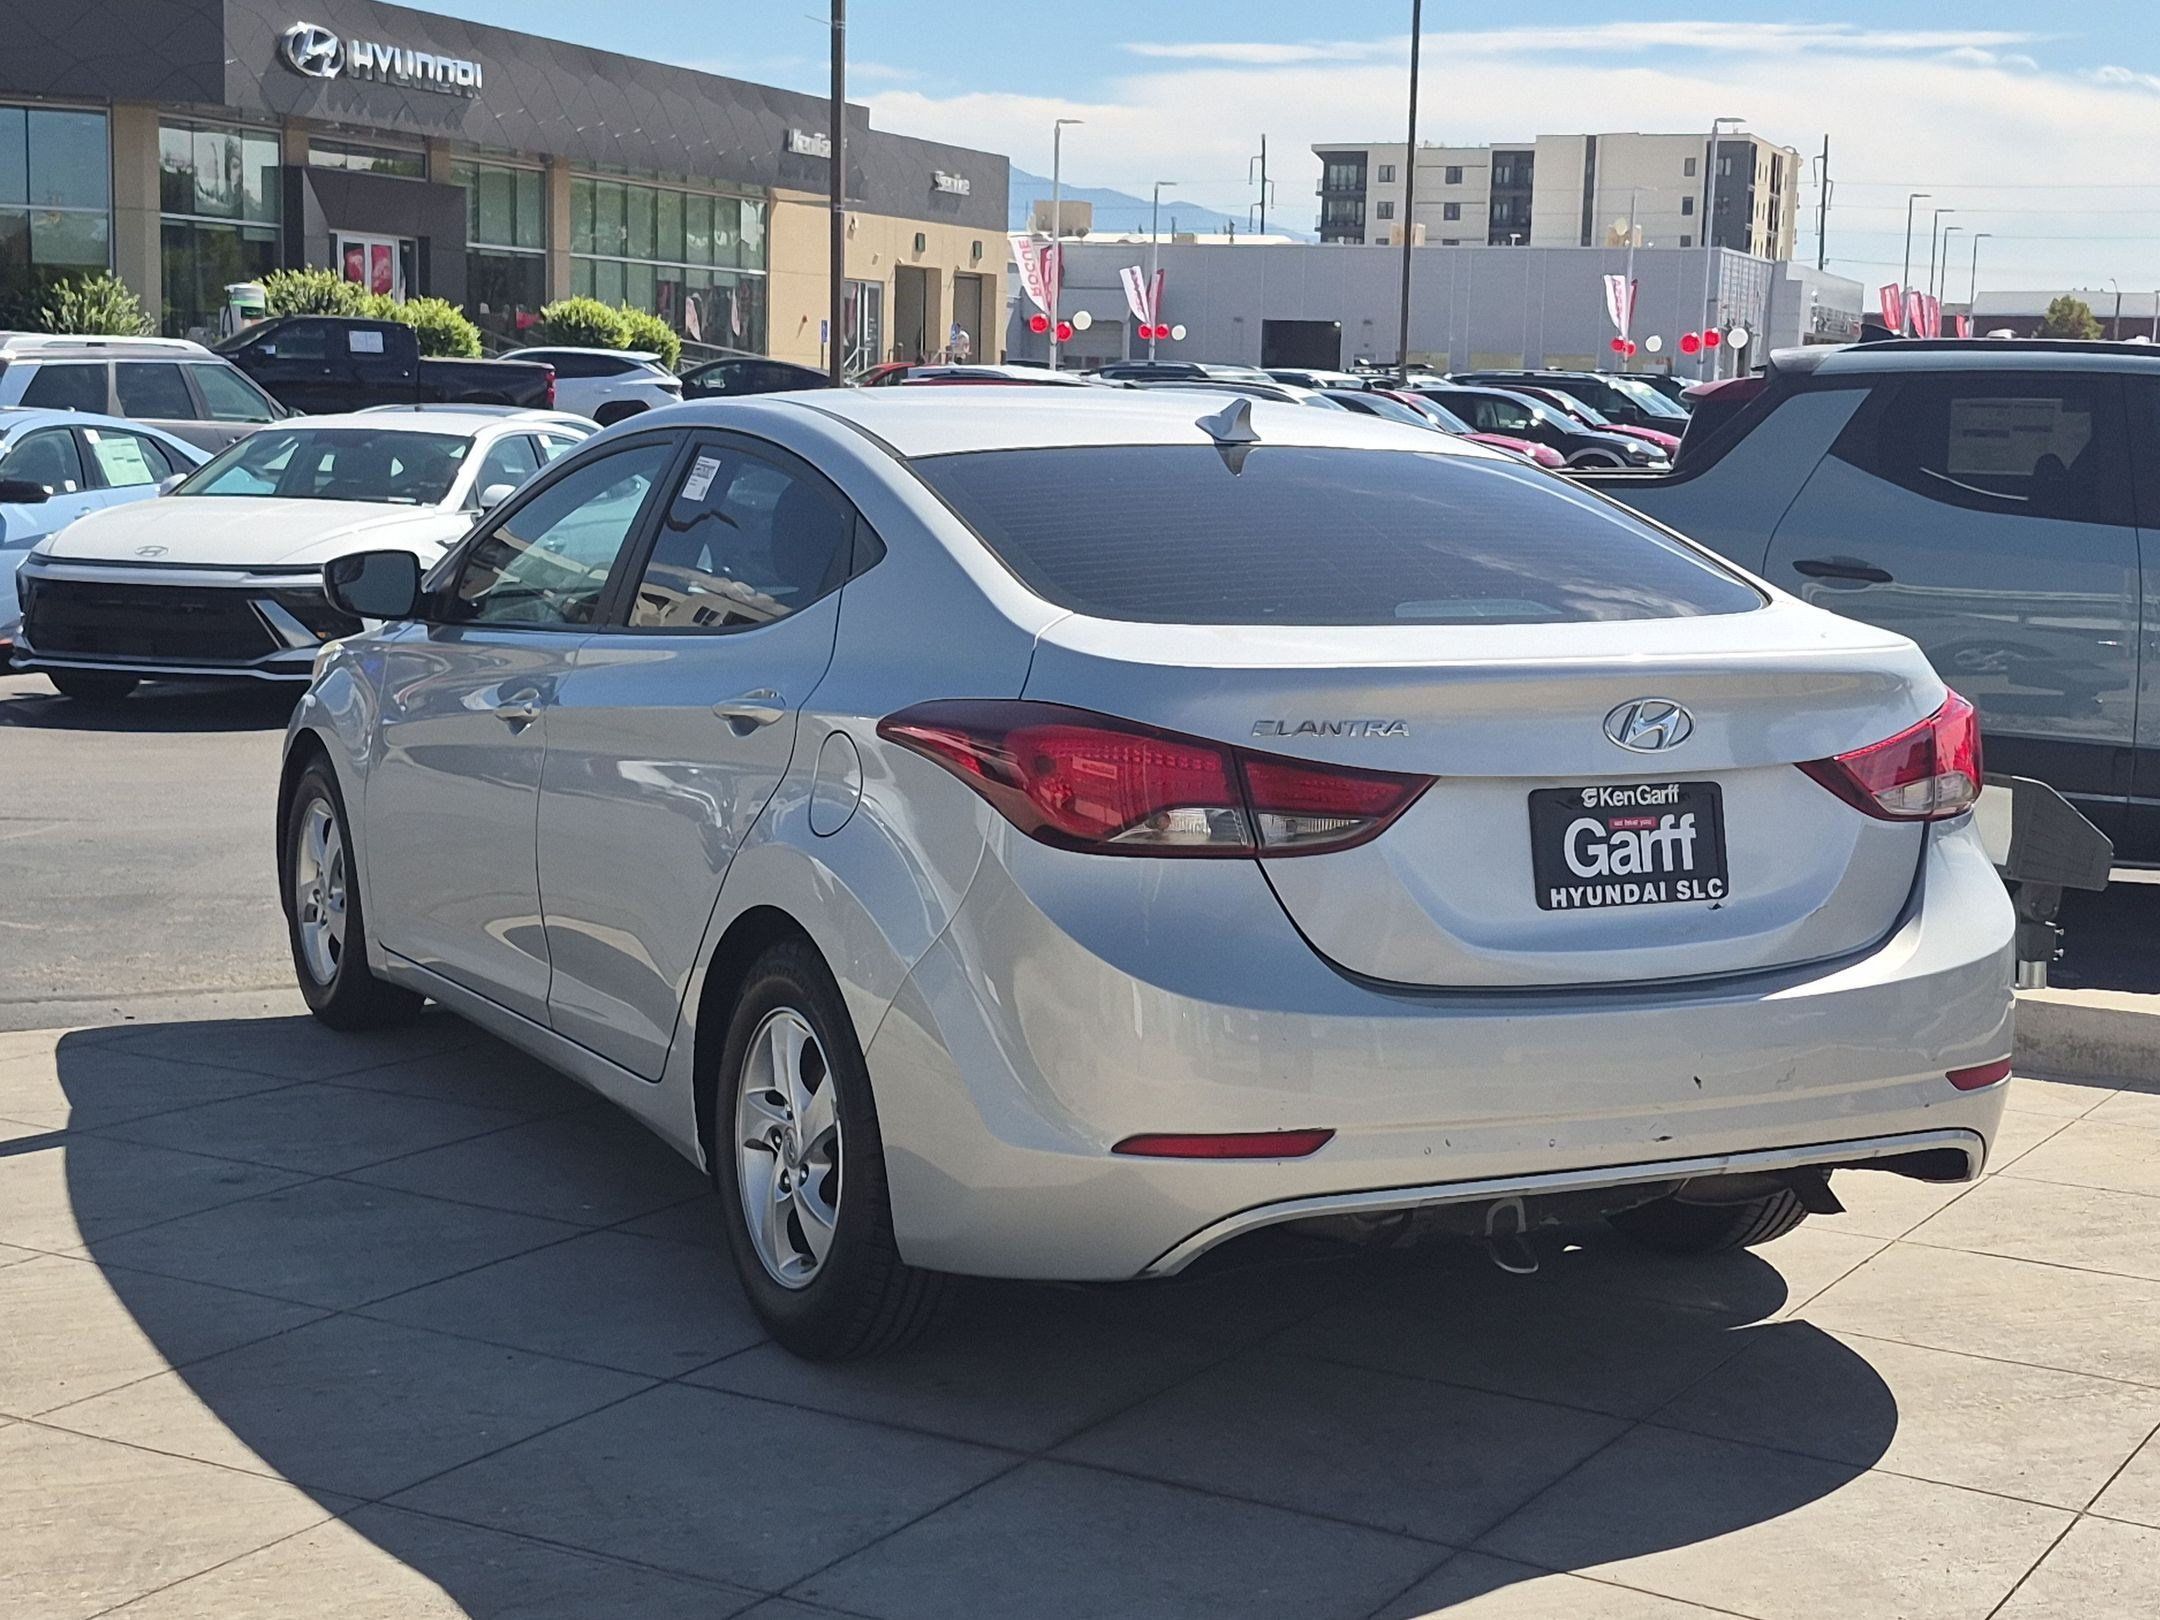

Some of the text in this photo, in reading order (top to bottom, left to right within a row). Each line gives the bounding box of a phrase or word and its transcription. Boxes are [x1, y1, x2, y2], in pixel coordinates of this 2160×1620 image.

[351, 39, 483, 89] HYUNDAI
[1251, 719, 1410, 737] ELANTRA
[1563, 812, 1698, 879] Garff
[1550, 877, 1724, 908] HYUNDAI SLC
